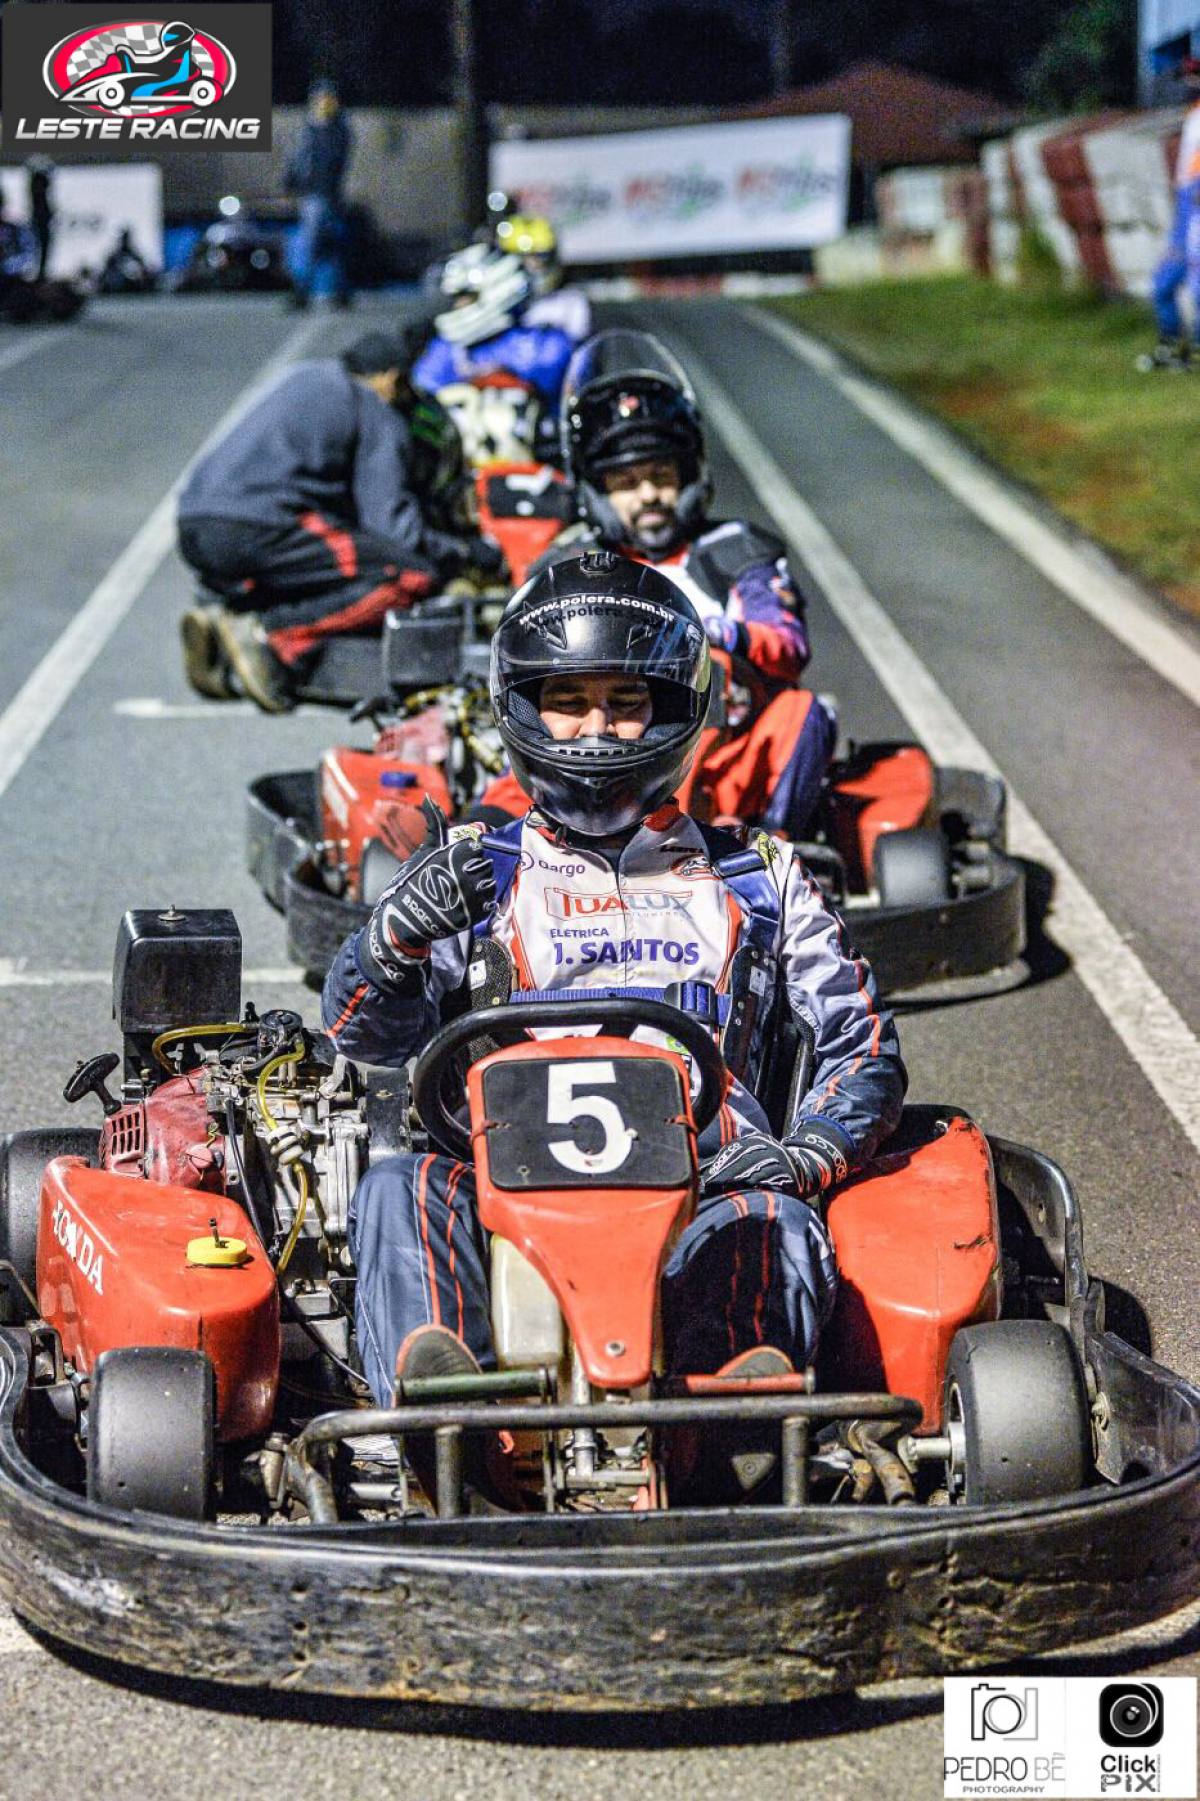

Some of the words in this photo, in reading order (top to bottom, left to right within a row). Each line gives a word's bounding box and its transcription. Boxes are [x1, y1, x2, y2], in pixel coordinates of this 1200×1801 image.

[519, 594, 674, 625] www.polera.com.br
[580, 938, 700, 966] SANTOS
[547, 1061, 632, 1174] 5
[52, 1199, 104, 1296] HONDA
